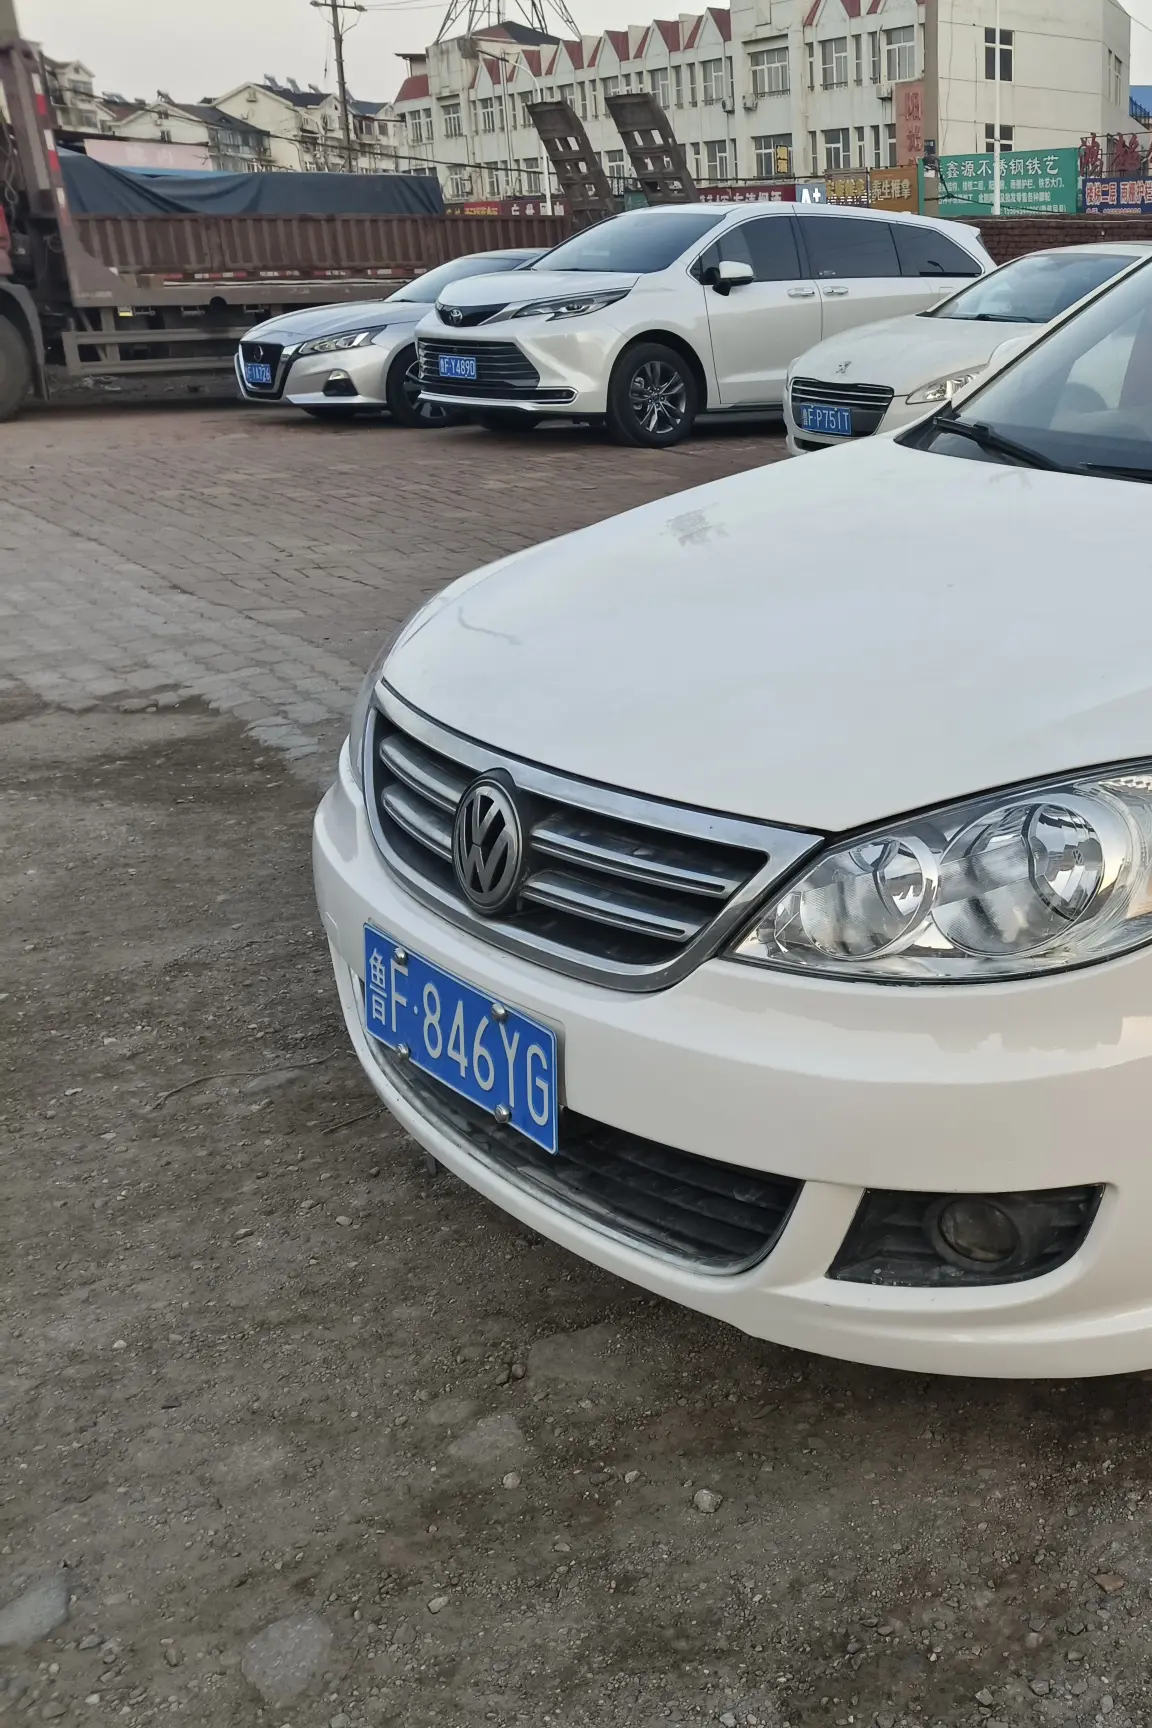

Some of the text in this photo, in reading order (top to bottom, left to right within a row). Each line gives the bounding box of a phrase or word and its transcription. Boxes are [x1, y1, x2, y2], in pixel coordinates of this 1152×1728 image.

[938, 155, 1059, 179] 鑫源不锈钢铁艺
[871, 178, 913, 201] 养生推拿
[368, 946, 550, 1127] 鲁F·846YG
